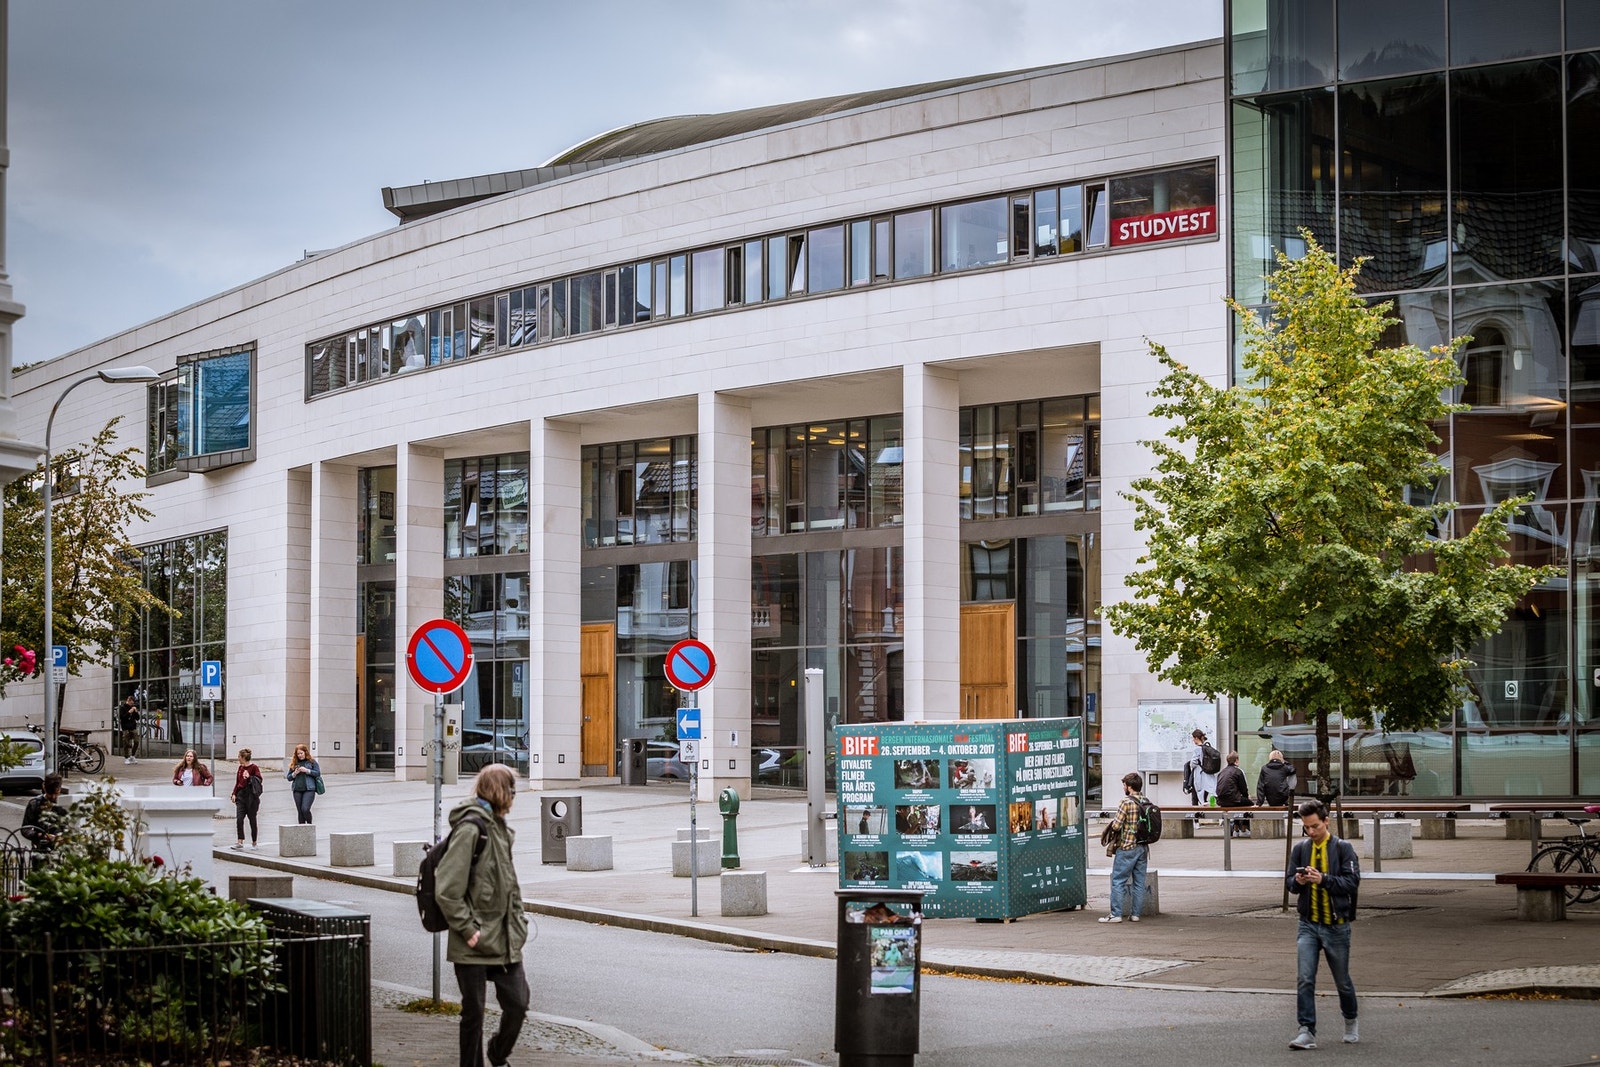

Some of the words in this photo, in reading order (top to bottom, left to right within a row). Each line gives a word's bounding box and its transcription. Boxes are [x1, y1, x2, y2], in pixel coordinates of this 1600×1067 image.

[1120, 212, 1210, 240] STUDVEST
[53, 649, 63, 665] P
[206, 664, 216, 684] P
[846, 736, 876, 755] BIFF
[881, 736, 904, 744] BERGEN
[904, 735, 952, 744] INTERNASJONALE
[1010, 733, 1026, 752] BIFF
[881, 746, 891, 755] 26.
[893, 746, 930, 755] SEPTEMBER
[939, 745, 946, 755] 4.
[948, 745, 978, 755] OKTOBER
[979, 744, 995, 754] 2017
[841, 760, 872, 770] UTVALGTE
[1025, 756, 1034, 768] MER
[1052, 753, 1065, 766] FILMER
[842, 771, 865, 781] FILMER
[1016, 768, 1022, 782] PÅ
[842, 782, 854, 792] FRA
[855, 779, 875, 792] ÅRETS
[842, 793, 874, 803] PROGRAM
